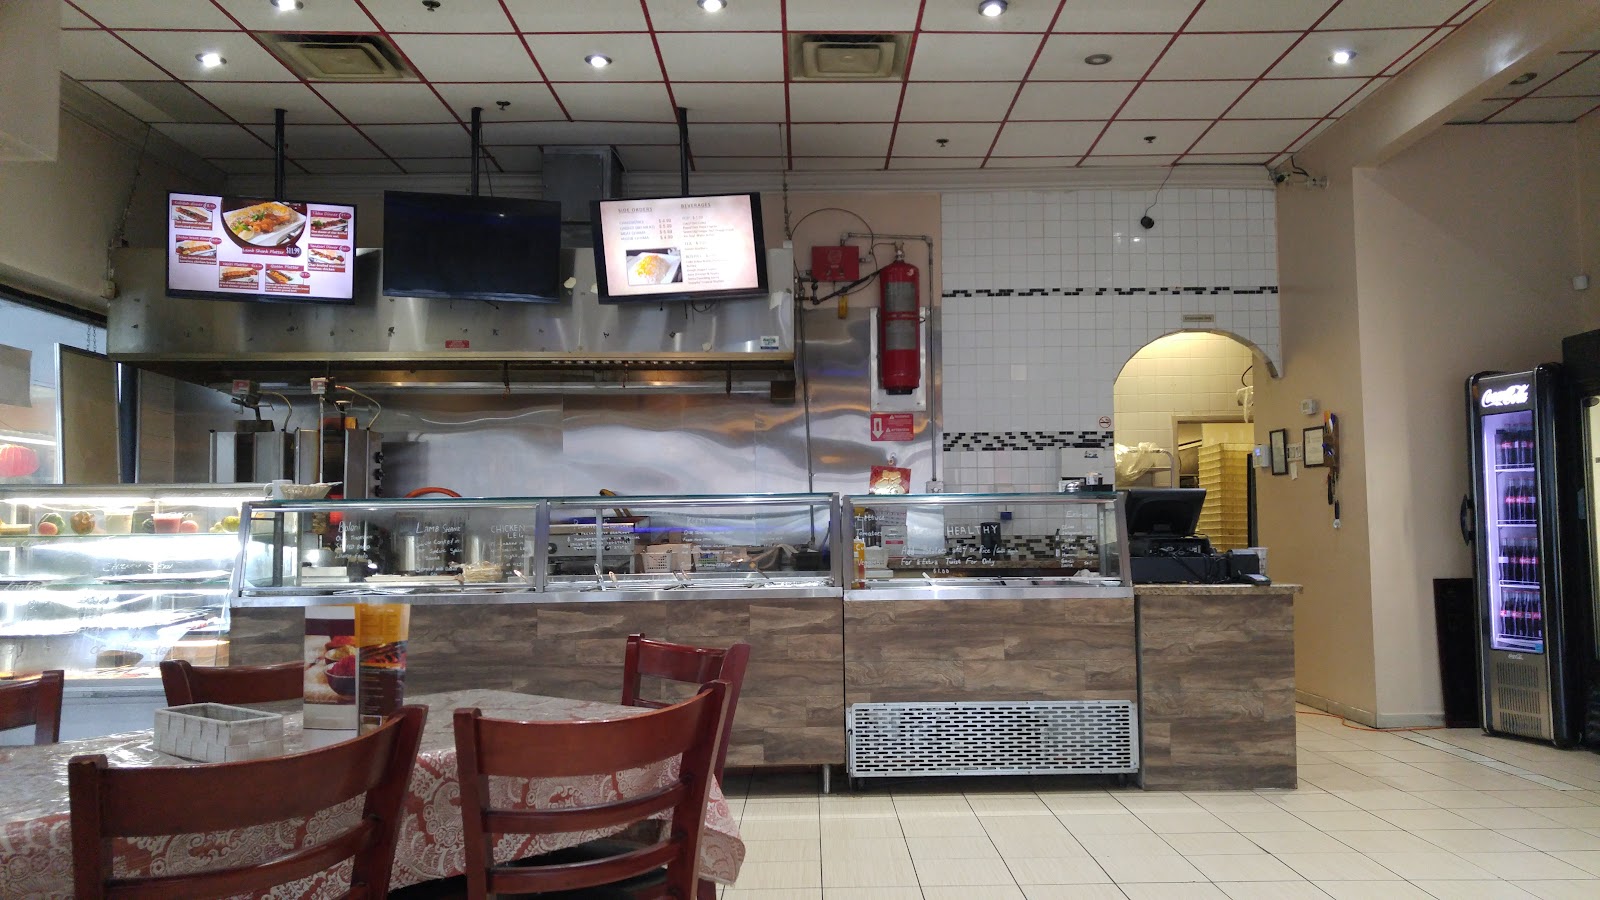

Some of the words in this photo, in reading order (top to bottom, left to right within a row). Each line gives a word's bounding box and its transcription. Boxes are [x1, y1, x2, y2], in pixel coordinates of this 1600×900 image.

[285, 246, 300, 255] $11.99
[415, 521, 440, 534] LAMB
[490, 524, 526, 534] CHICKEN
[946, 524, 998, 536] HEALTHY
[965, 557, 978, 565] For
[982, 557, 996, 567] Only
